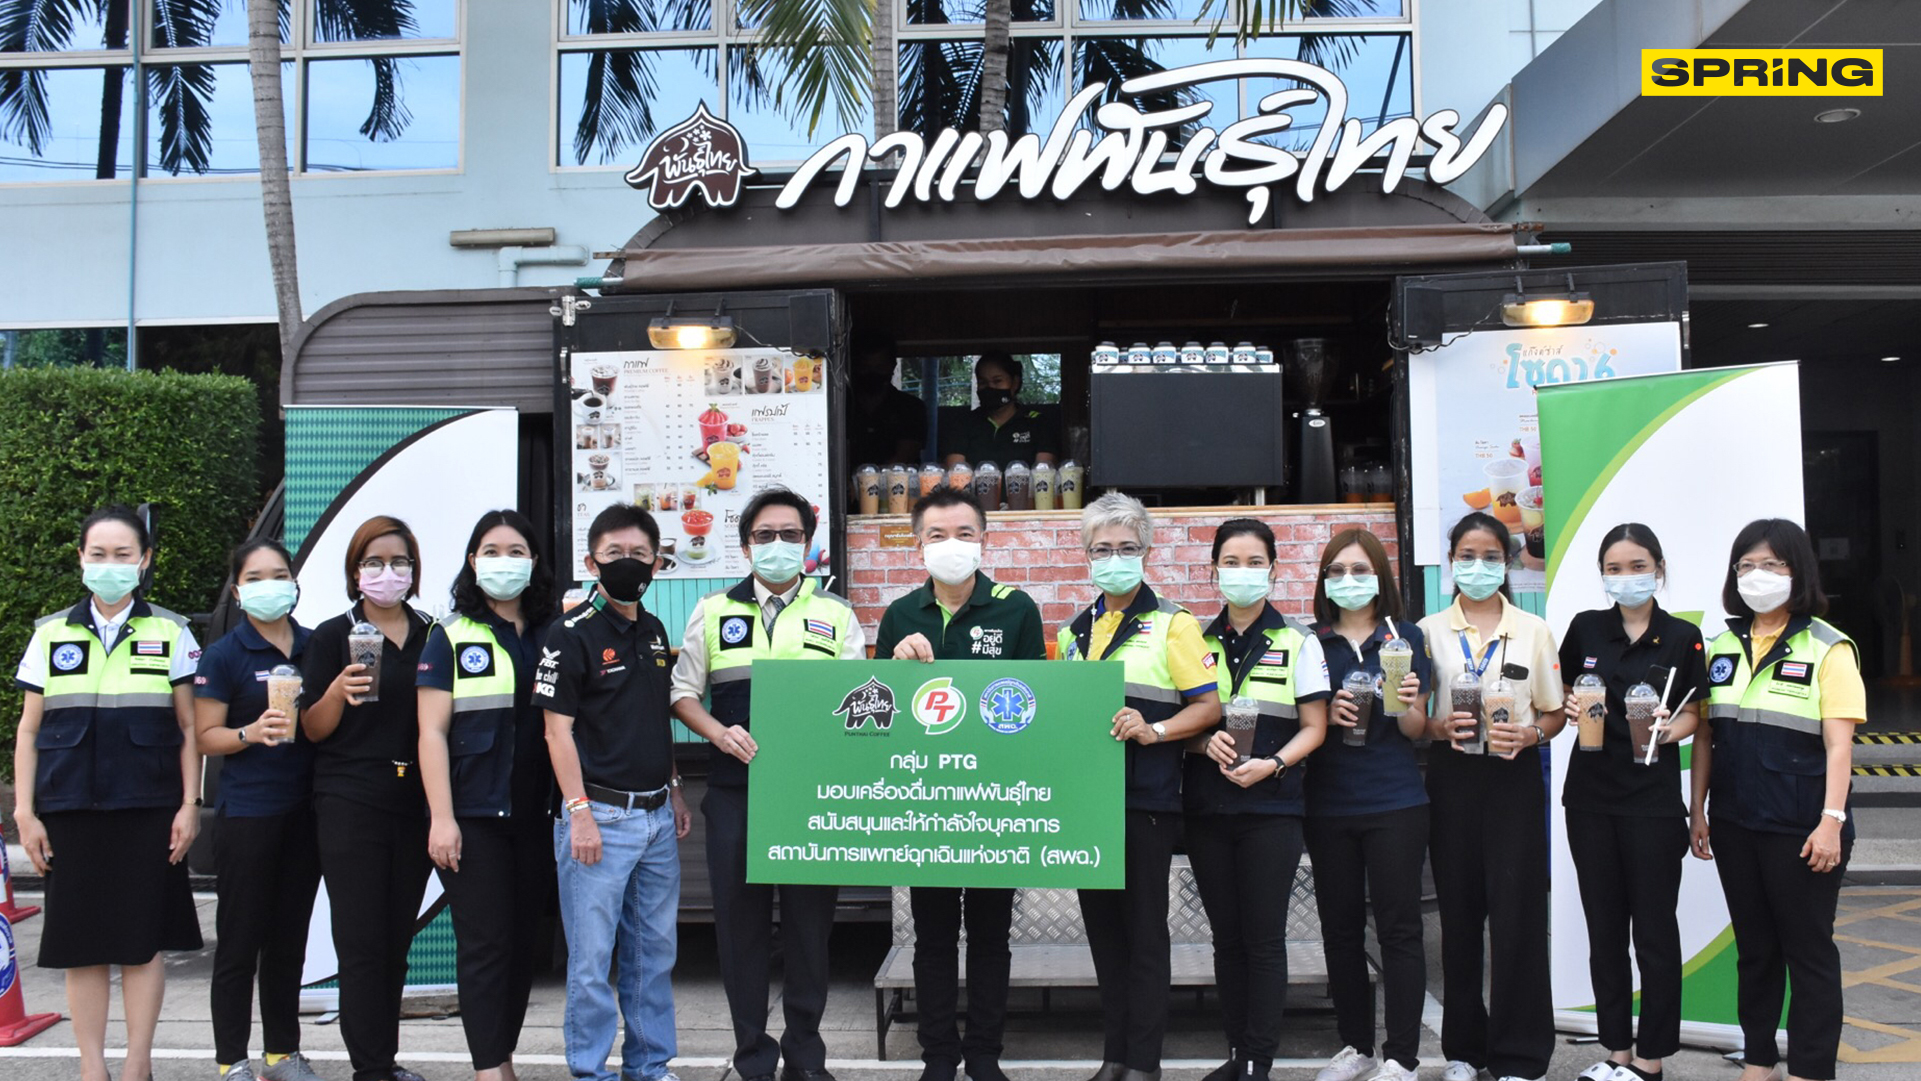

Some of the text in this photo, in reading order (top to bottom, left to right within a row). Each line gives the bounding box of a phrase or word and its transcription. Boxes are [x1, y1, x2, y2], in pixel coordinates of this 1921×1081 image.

[775, 57, 1508, 225] กาแฟพันธุ์ไทย
[658, 140, 738, 179] พันธุ์ไทย
[925, 691, 955, 722] PT
[890, 750, 977, 774] กลุ่ม PTG
[817, 777, 1051, 806] มอบเครื่องดื่มกาแฟพันธุ์ไทย
[807, 810, 1061, 837] สนับสนุนและให้กำลังใจบุคลากร
[767, 843, 1101, 868] สถาบันการแพทย์ฉุกเฉินแห่งชาติ (สพฉ.)
